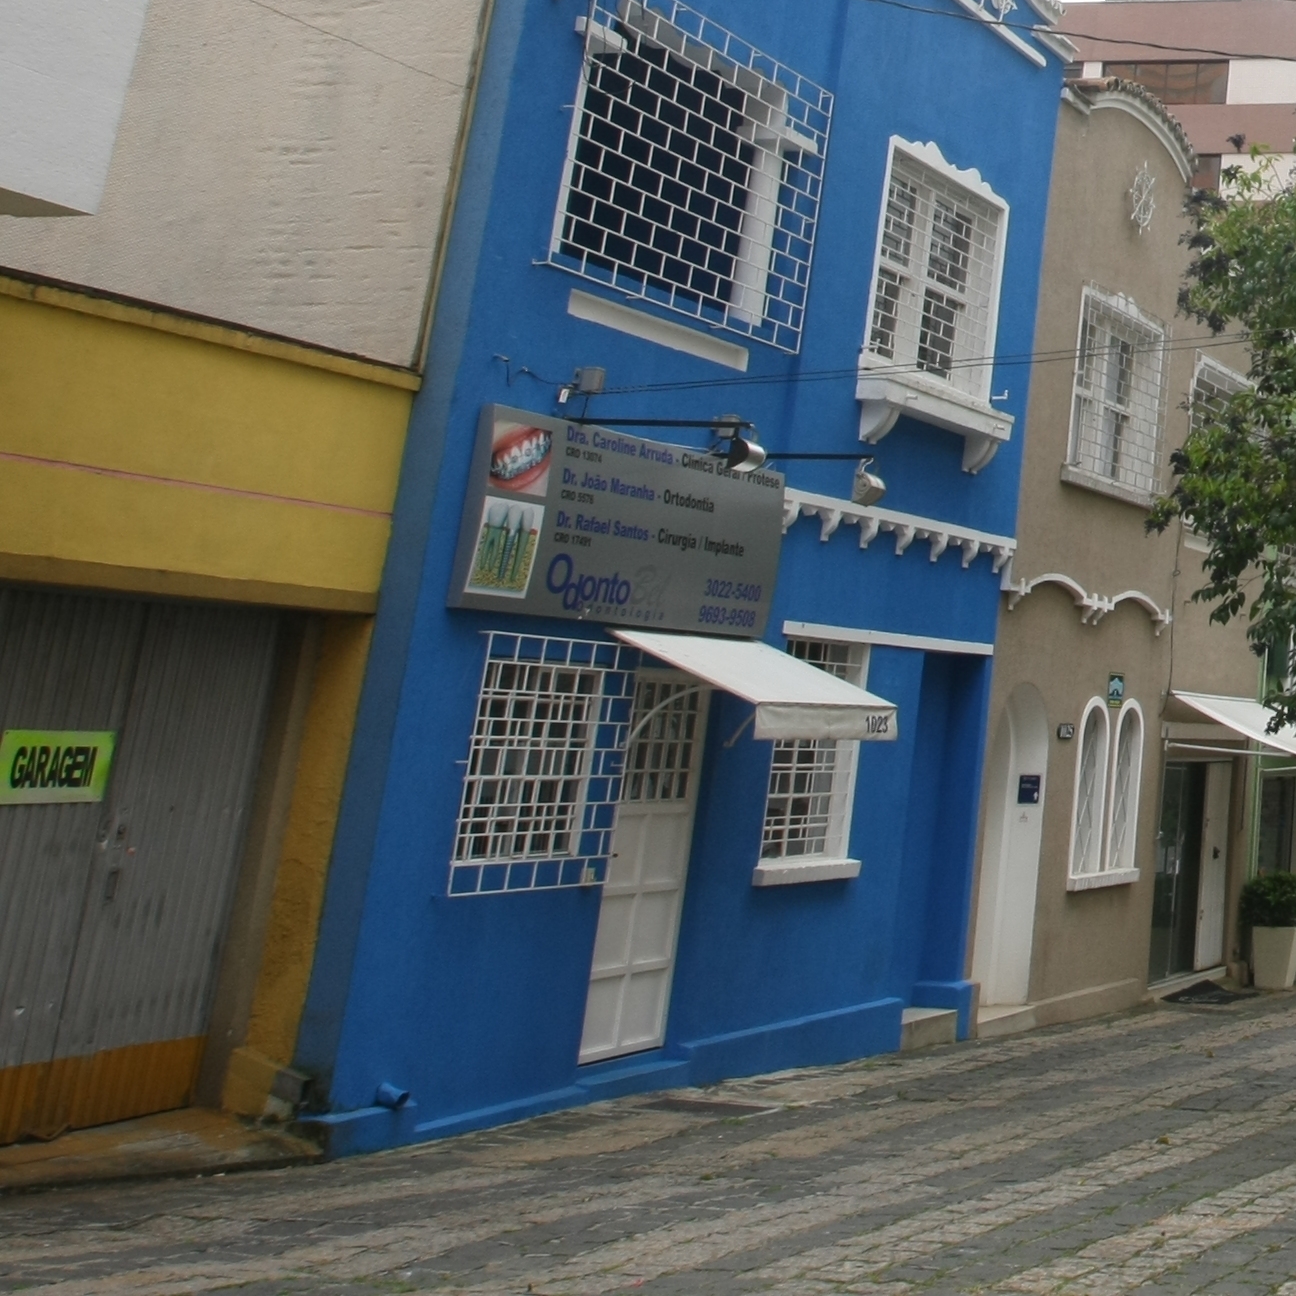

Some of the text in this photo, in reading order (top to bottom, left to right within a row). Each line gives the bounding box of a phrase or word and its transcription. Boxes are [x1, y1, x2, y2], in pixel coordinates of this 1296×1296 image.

[565, 446, 580, 459] CRO
[566, 425, 589, 445] Dra.
[592, 432, 637, 456] Caroline
[639, 444, 674, 464] Arruda
[561, 489, 576, 501] CRO
[562, 468, 578, 485] Dr.
[581, 472, 608, 491] João
[610, 477, 655, 501] Maranha
[663, 489, 715, 513] Ortodontia
[554, 532, 570, 544] CRO
[556, 510, 571, 528] Dr.
[575, 513, 611, 535] Rafael
[613, 521, 649, 541] Santos
[657, 528, 697, 551] Cirurgia
[704, 536, 744, 557] Implante
[704, 578, 762, 602] 3022-5400
[698, 605, 756, 628] 9693-9508
[865, 715, 889, 733] 1023
[9, 745, 98, 789] GARAGEM
